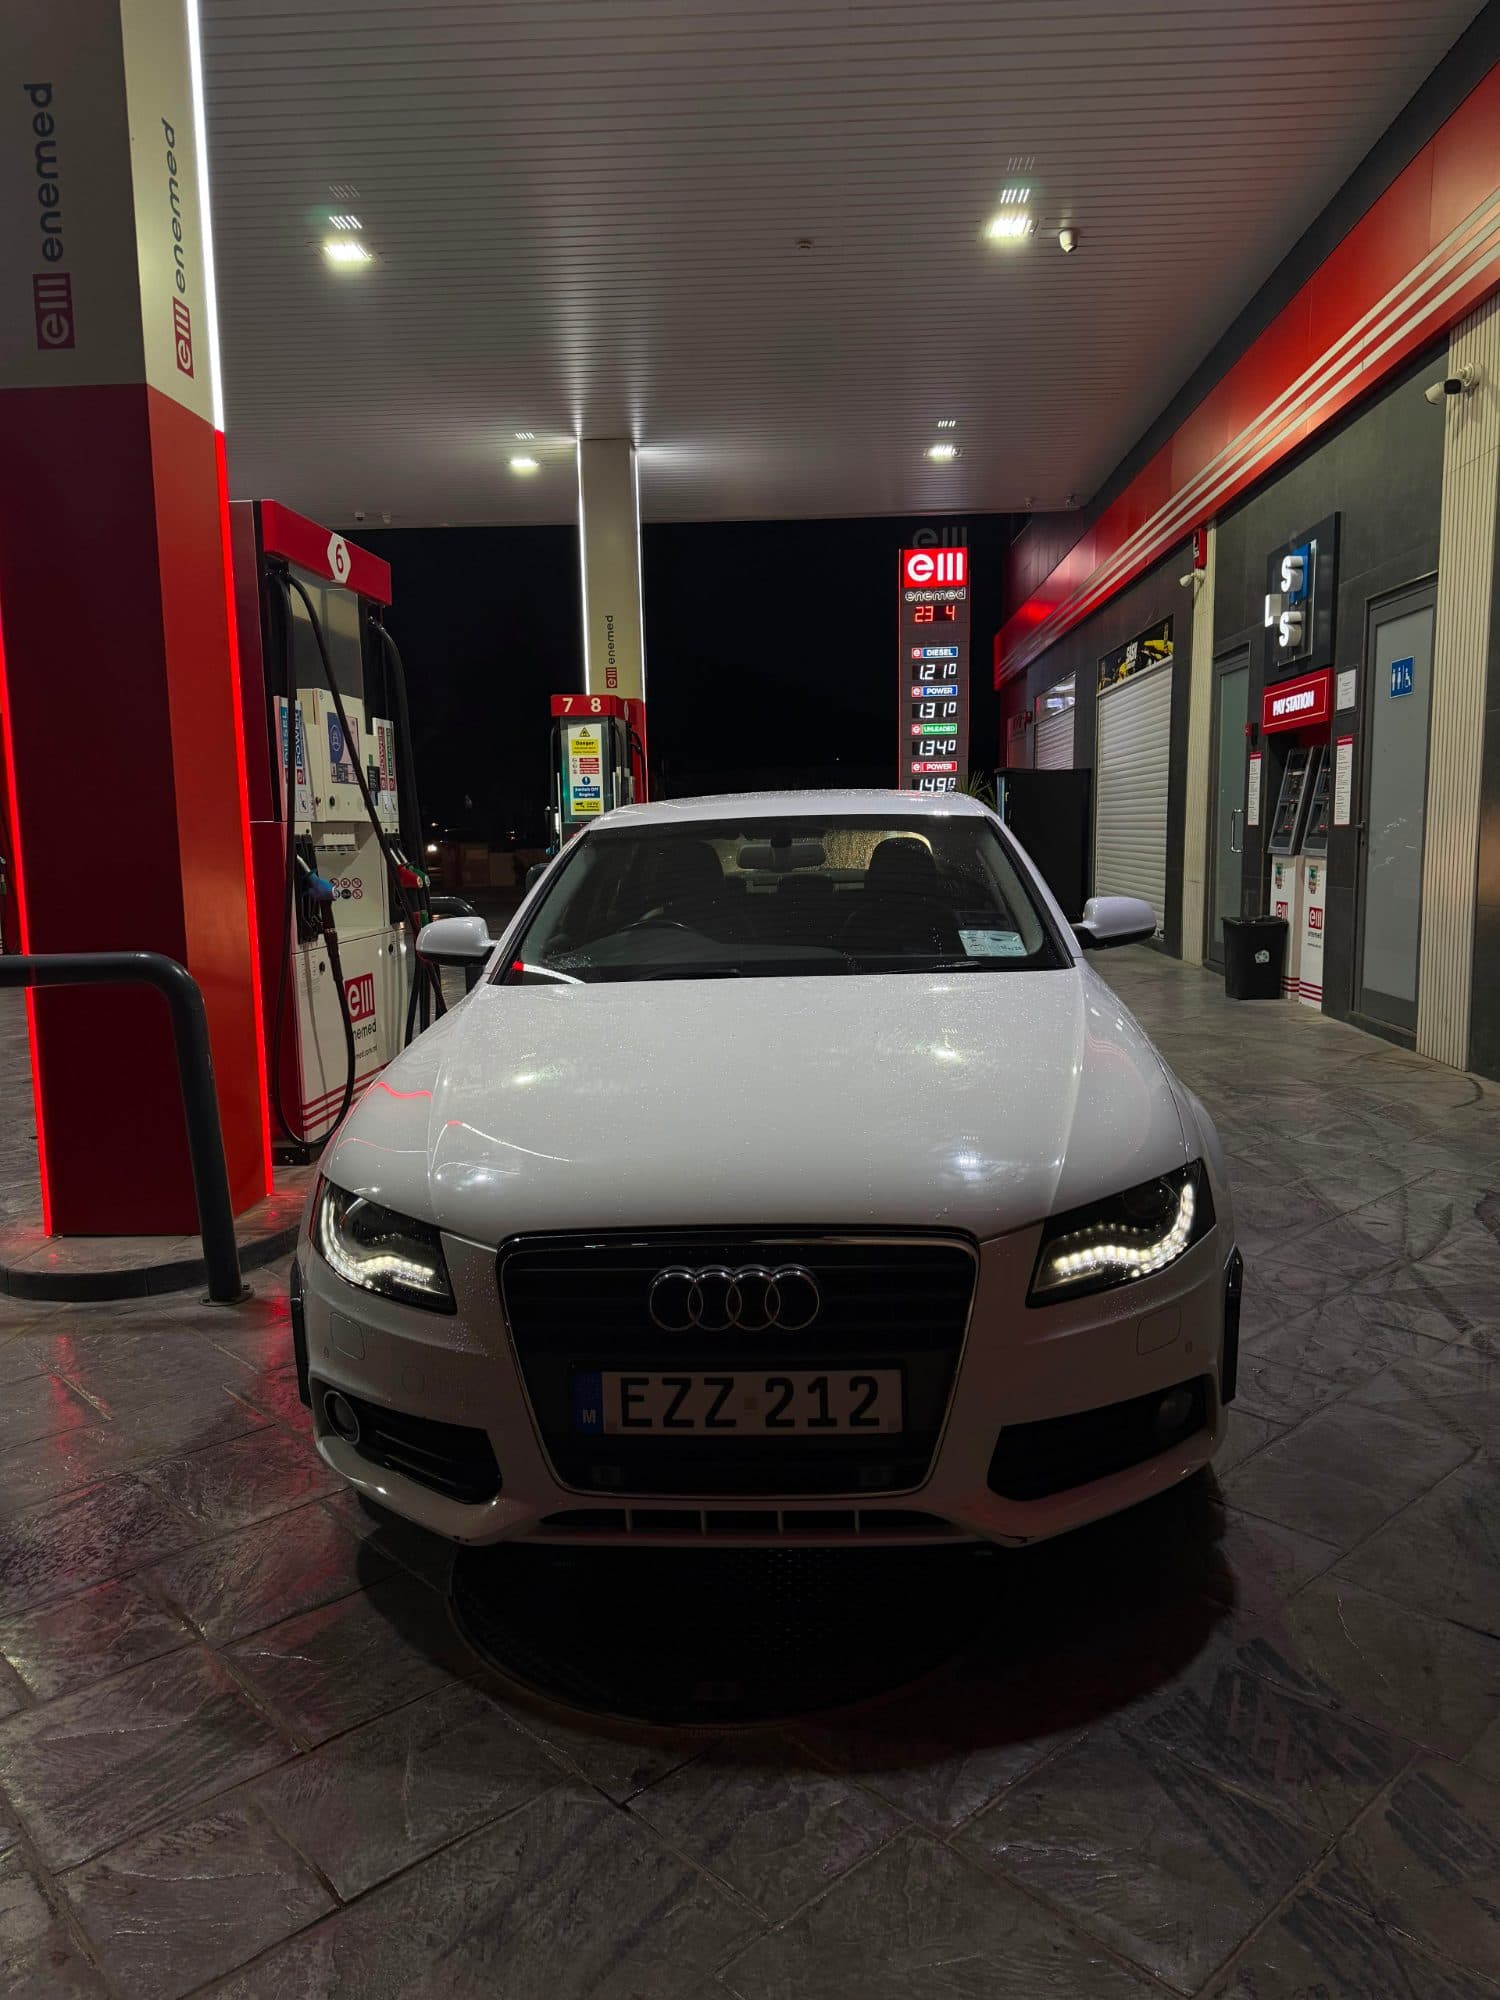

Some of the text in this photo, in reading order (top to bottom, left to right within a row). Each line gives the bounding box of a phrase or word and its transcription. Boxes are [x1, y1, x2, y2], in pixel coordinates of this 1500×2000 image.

[24, 82, 64, 263] enemed
[161, 117, 186, 294] enemed
[335, 543, 344, 574] 6
[905, 588, 966, 602] enemed
[605, 615, 616, 664] enemed
[925, 648, 953, 656] DIESEL
[926, 687, 953, 695] POWER
[562, 697, 602, 713] 7 8
[1273, 698, 1286, 717] PAY
[1285, 690, 1315, 713] STATION
[924, 725, 956, 733] UNLEADED
[926, 763, 953, 771] POWER
[582, 1377, 881, 1428] M EZZ 212
